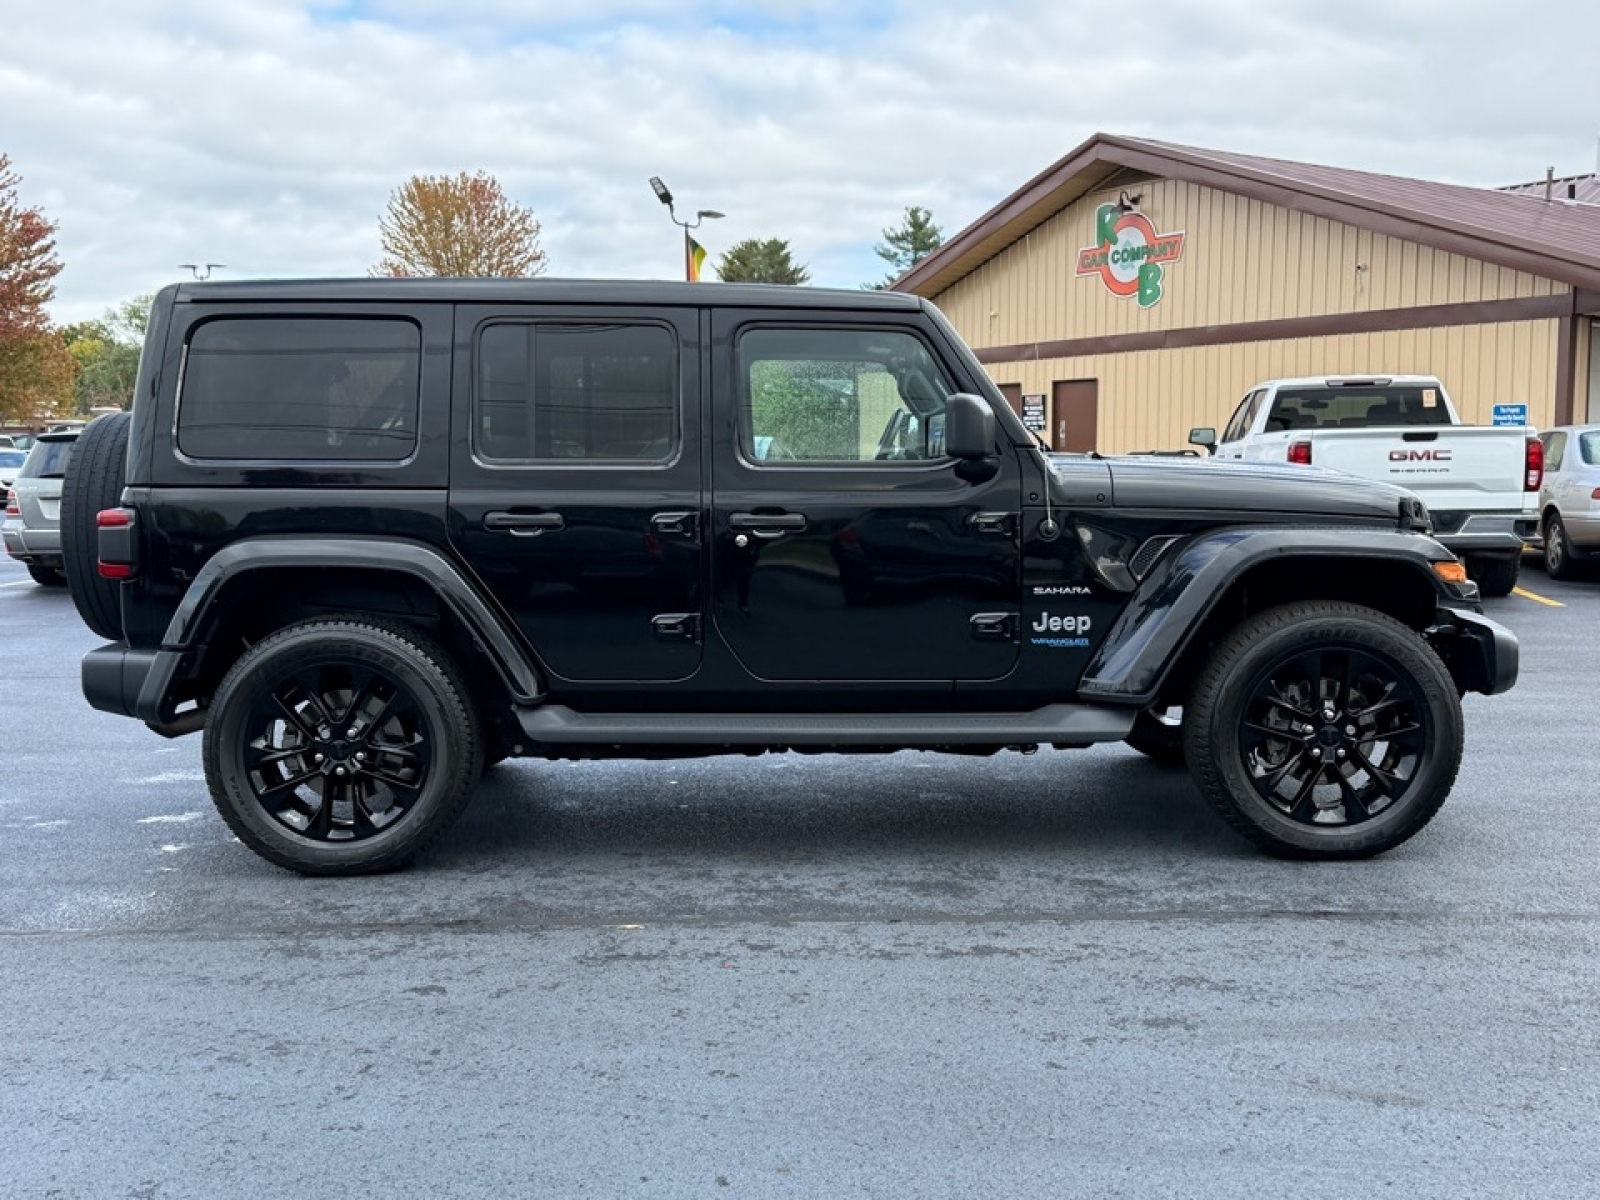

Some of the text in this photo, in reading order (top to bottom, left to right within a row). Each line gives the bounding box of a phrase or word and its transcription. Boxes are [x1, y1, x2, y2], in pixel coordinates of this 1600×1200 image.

[1111, 241, 1177, 264] COMPANY
[1389, 450, 1452, 461] GMC
[1033, 586, 1092, 595] SAHARA
[1032, 611, 1091, 635] Jeep
